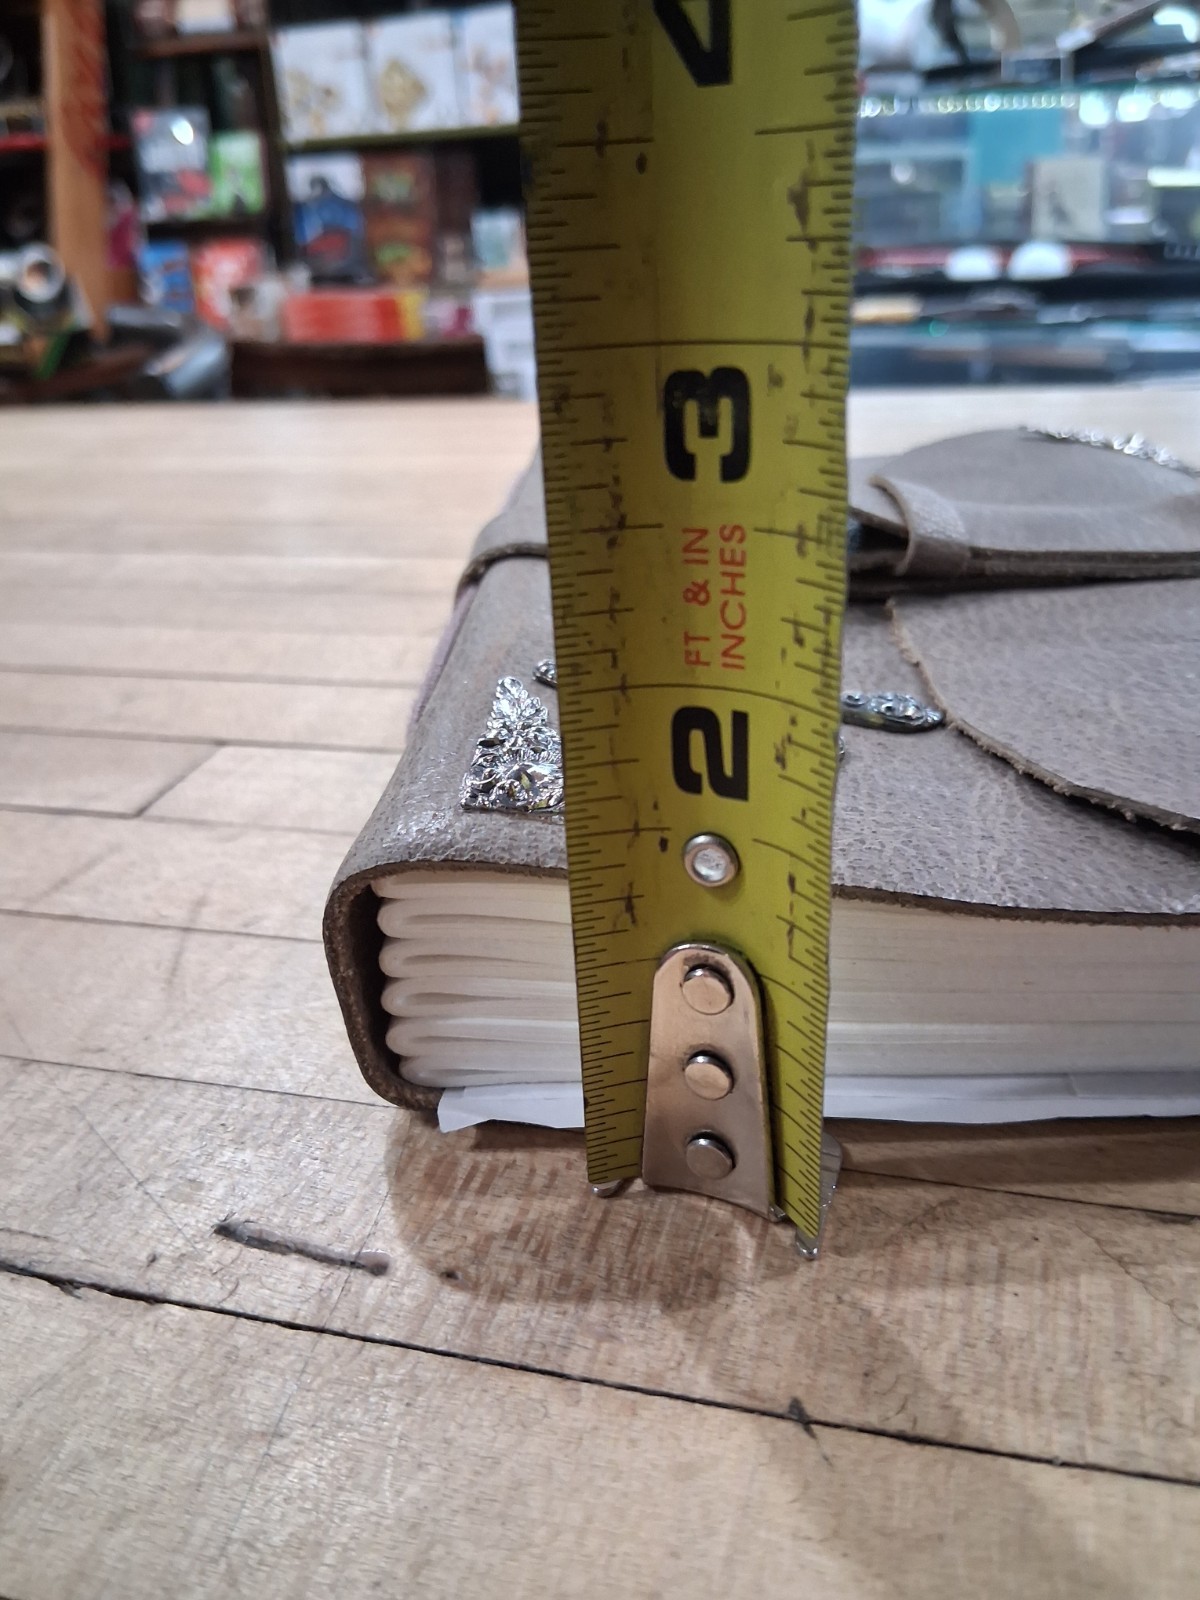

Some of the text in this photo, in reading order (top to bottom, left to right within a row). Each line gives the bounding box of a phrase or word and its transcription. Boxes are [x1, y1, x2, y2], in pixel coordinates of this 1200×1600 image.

[664, 366, 750, 483] 3
[681, 527, 711, 667] FT & IN
[719, 524, 747, 670] INCHES
[671, 705, 749, 802] 2
